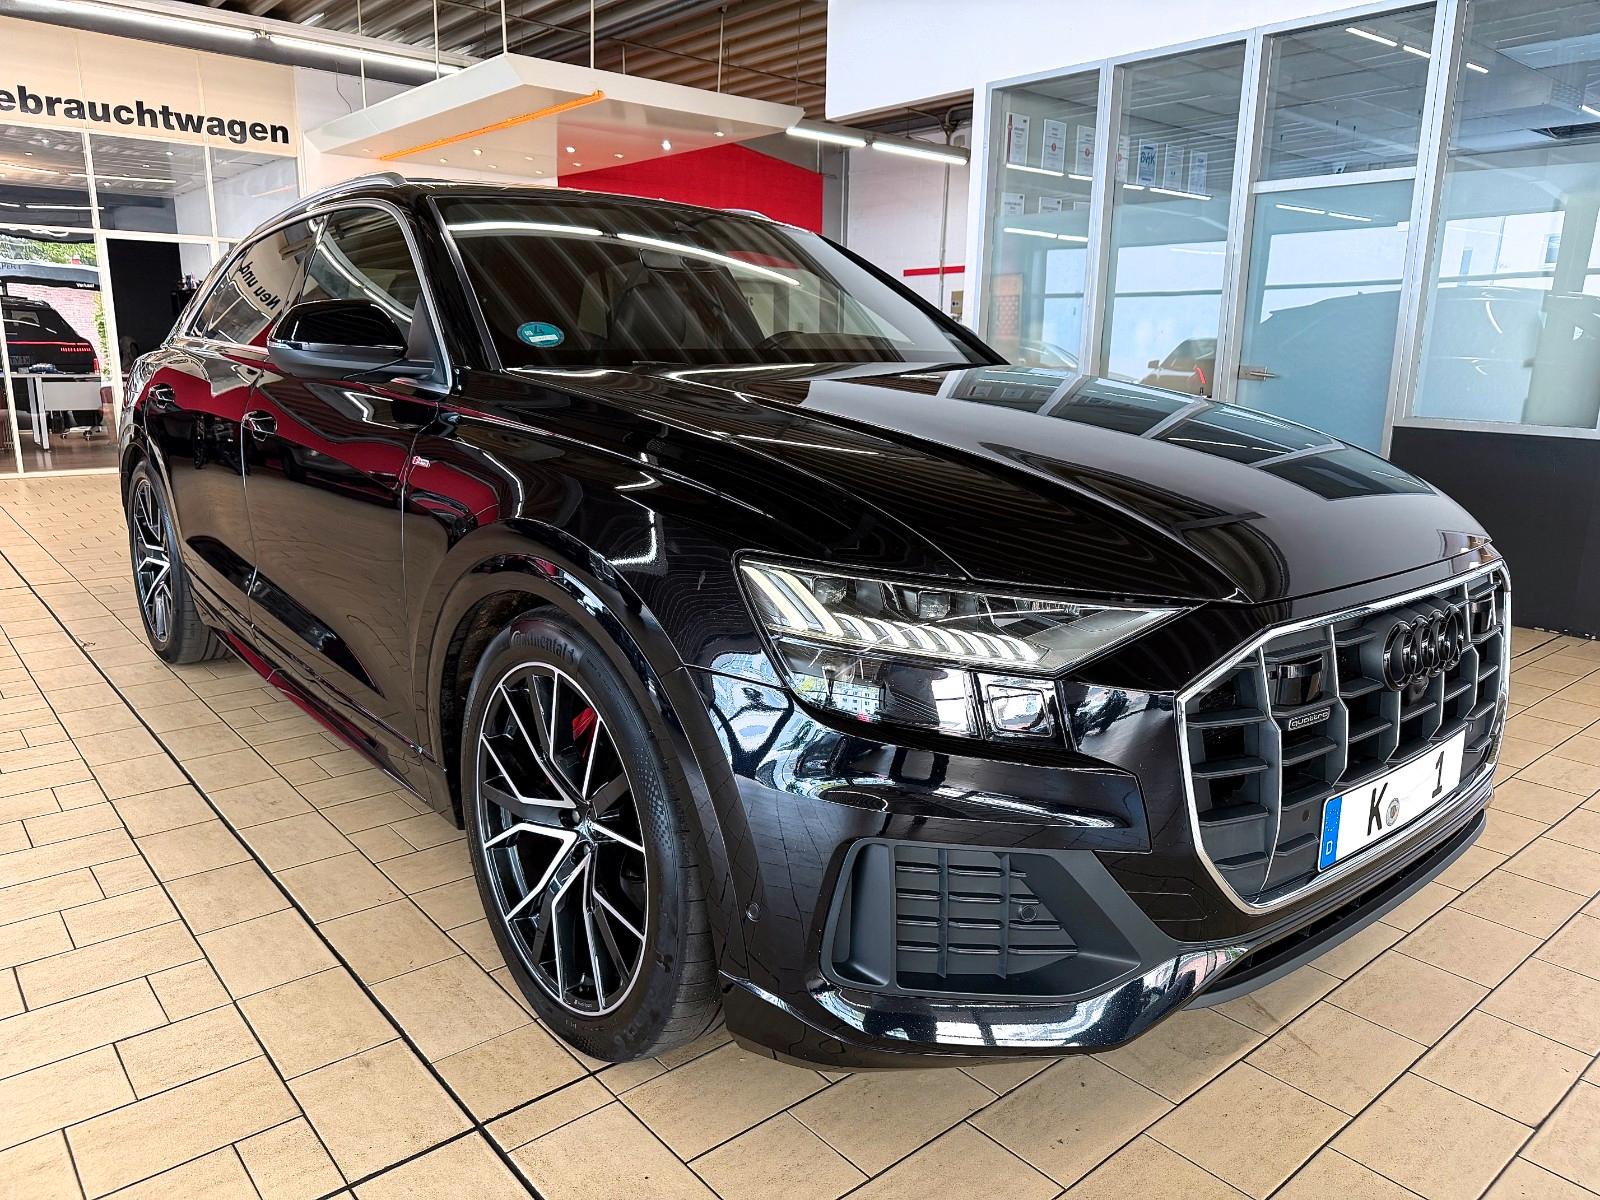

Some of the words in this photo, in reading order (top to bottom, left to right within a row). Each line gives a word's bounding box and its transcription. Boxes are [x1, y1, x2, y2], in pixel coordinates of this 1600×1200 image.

[1291, 711, 1329, 728] quattro
[1367, 782, 1389, 836] K
[1432, 750, 1445, 799] 1
[1326, 841, 1334, 855] D
